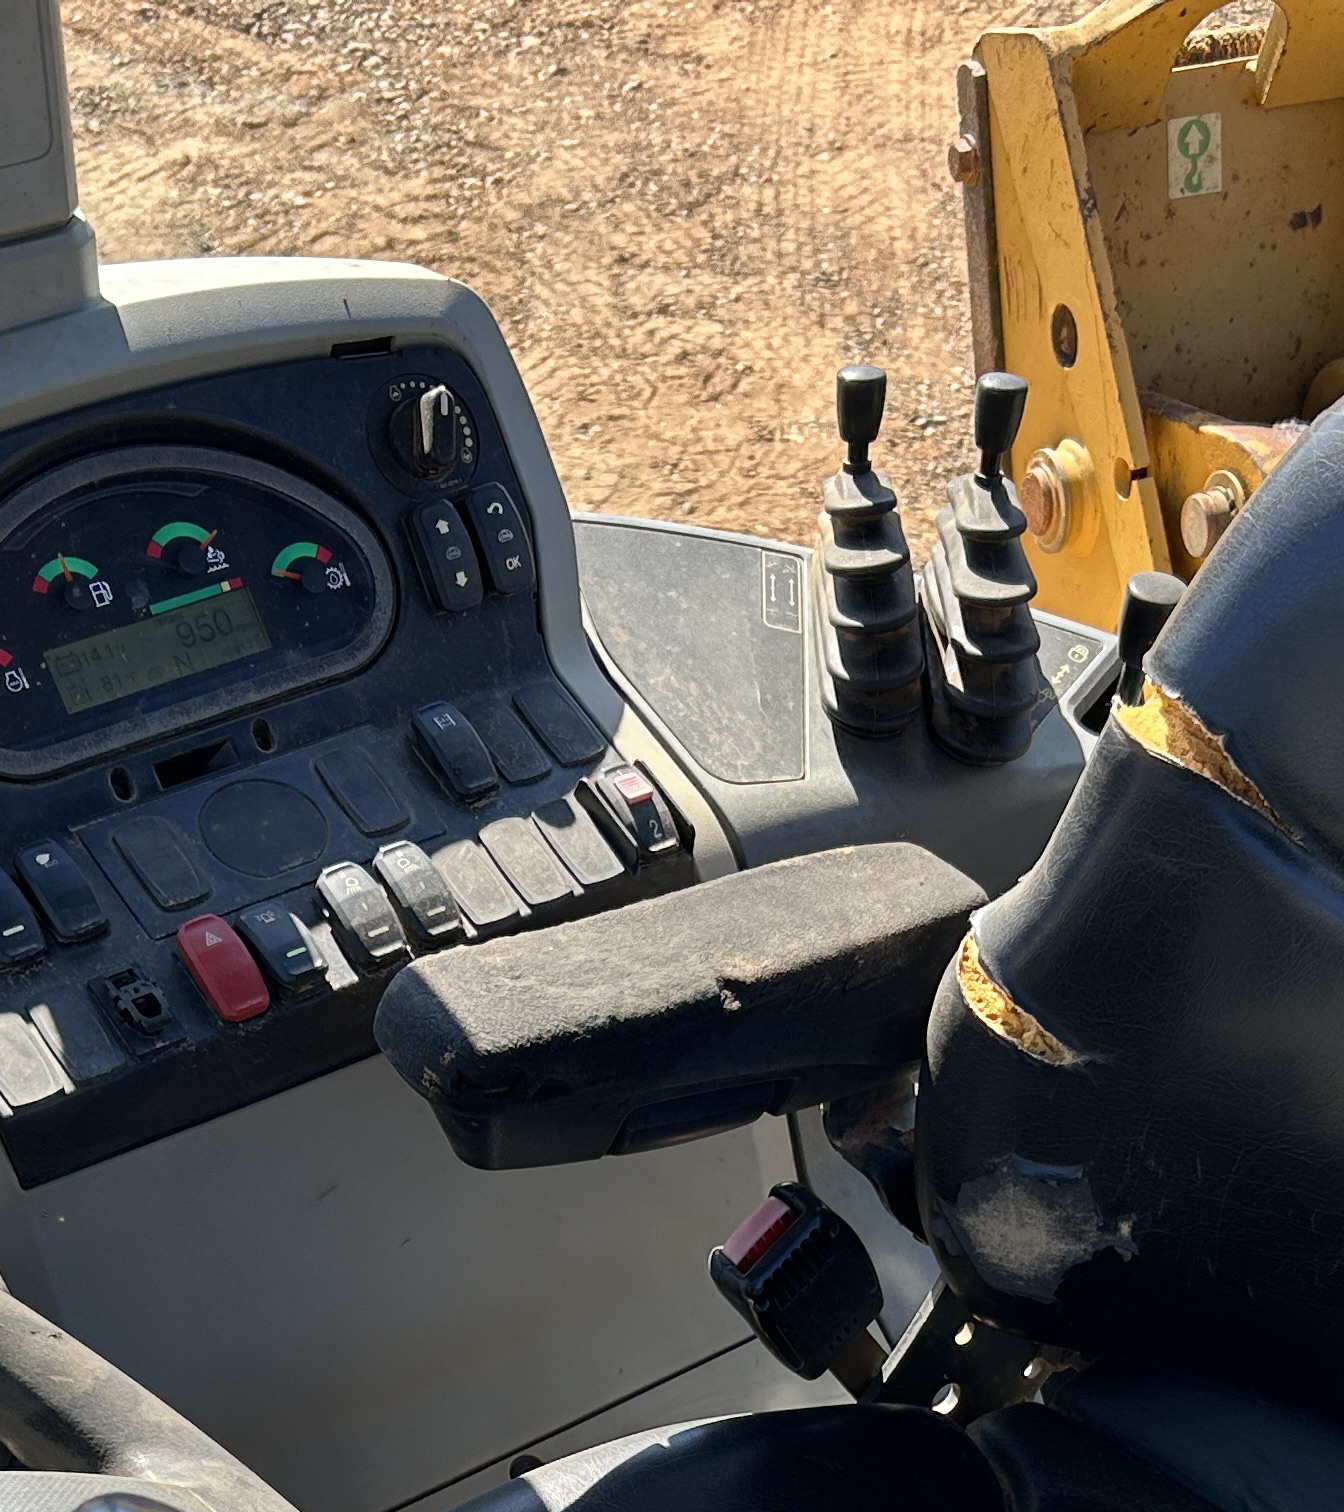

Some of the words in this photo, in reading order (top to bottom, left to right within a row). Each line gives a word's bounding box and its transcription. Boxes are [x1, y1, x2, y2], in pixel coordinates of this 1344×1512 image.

[505, 555, 522, 571] OK
[176, 608, 234, 649] 950
[173, 651, 194, 677] N
[649, 819, 663, 839] 2
